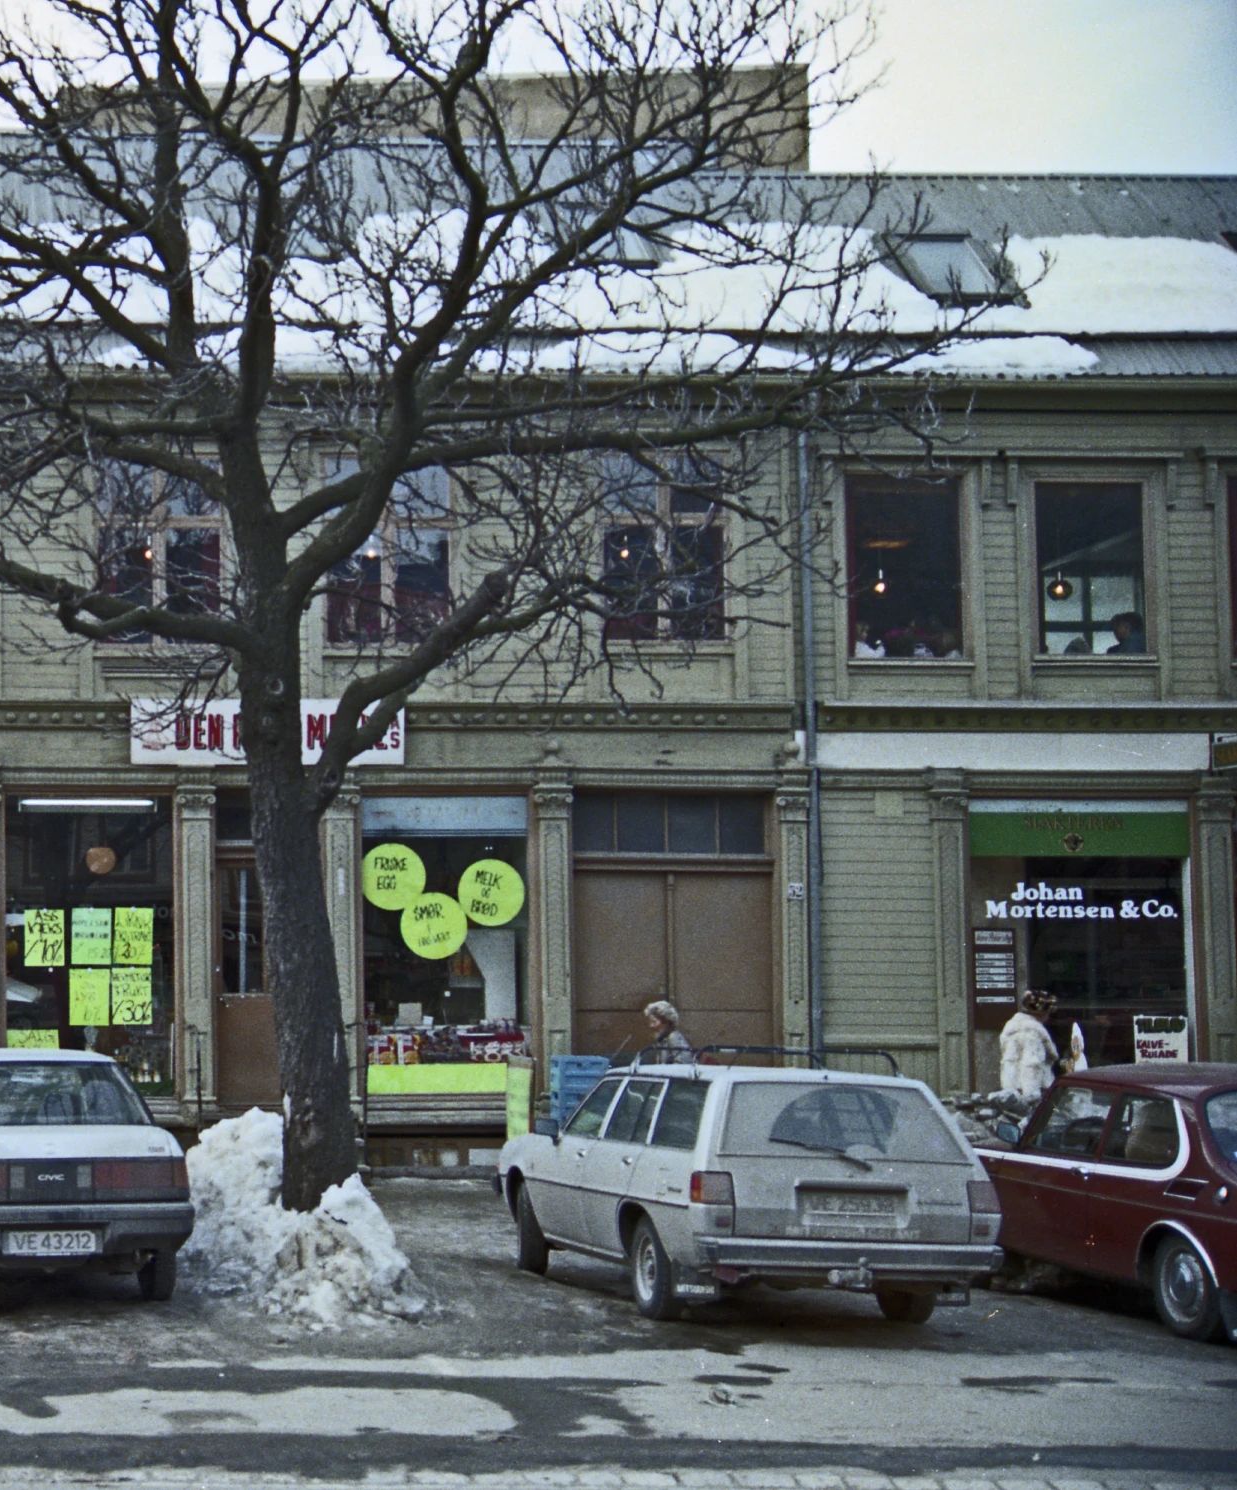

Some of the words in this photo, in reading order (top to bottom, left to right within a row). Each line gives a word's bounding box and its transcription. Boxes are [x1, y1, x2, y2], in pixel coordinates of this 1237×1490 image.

[377, 874, 396, 890] EGG
[475, 870, 503, 890] MELK
[1011, 882, 1083, 900] Johan
[985, 900, 1114, 918] Mortensen
[1140, 1049, 1178, 1059] RULADE
[37, 1173, 65, 1182] CIVIC
[13, 1233, 38, 1250] VE
[41, 1232, 92, 1250] 43212
